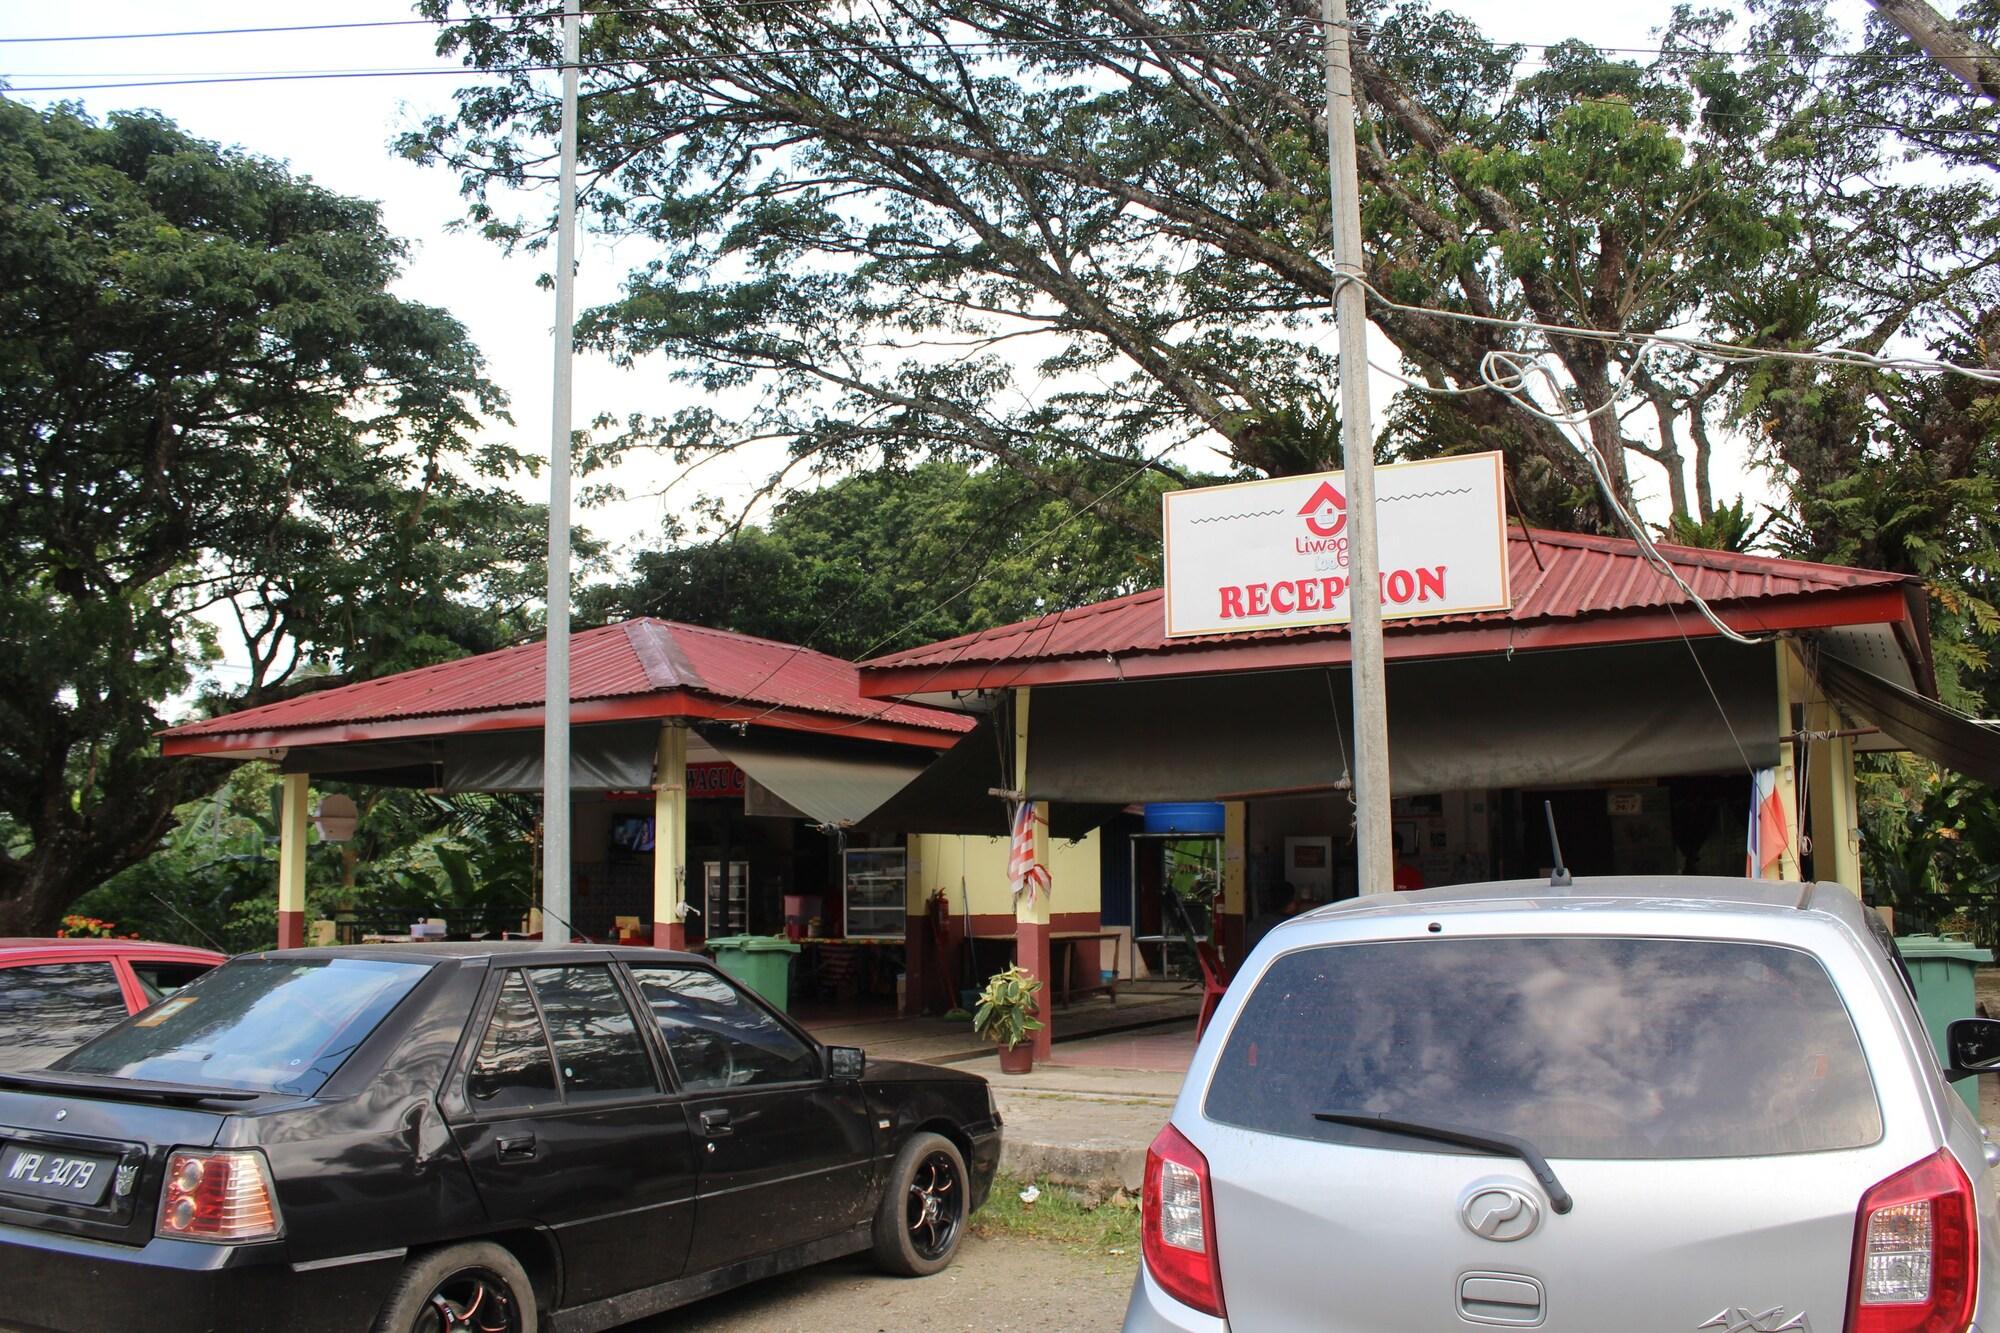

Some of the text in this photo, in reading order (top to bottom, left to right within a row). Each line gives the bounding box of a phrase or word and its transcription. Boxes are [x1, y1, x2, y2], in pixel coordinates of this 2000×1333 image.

[1219, 566, 1447, 619] RECEPION
[8, 1152, 97, 1189] WPL 3479
